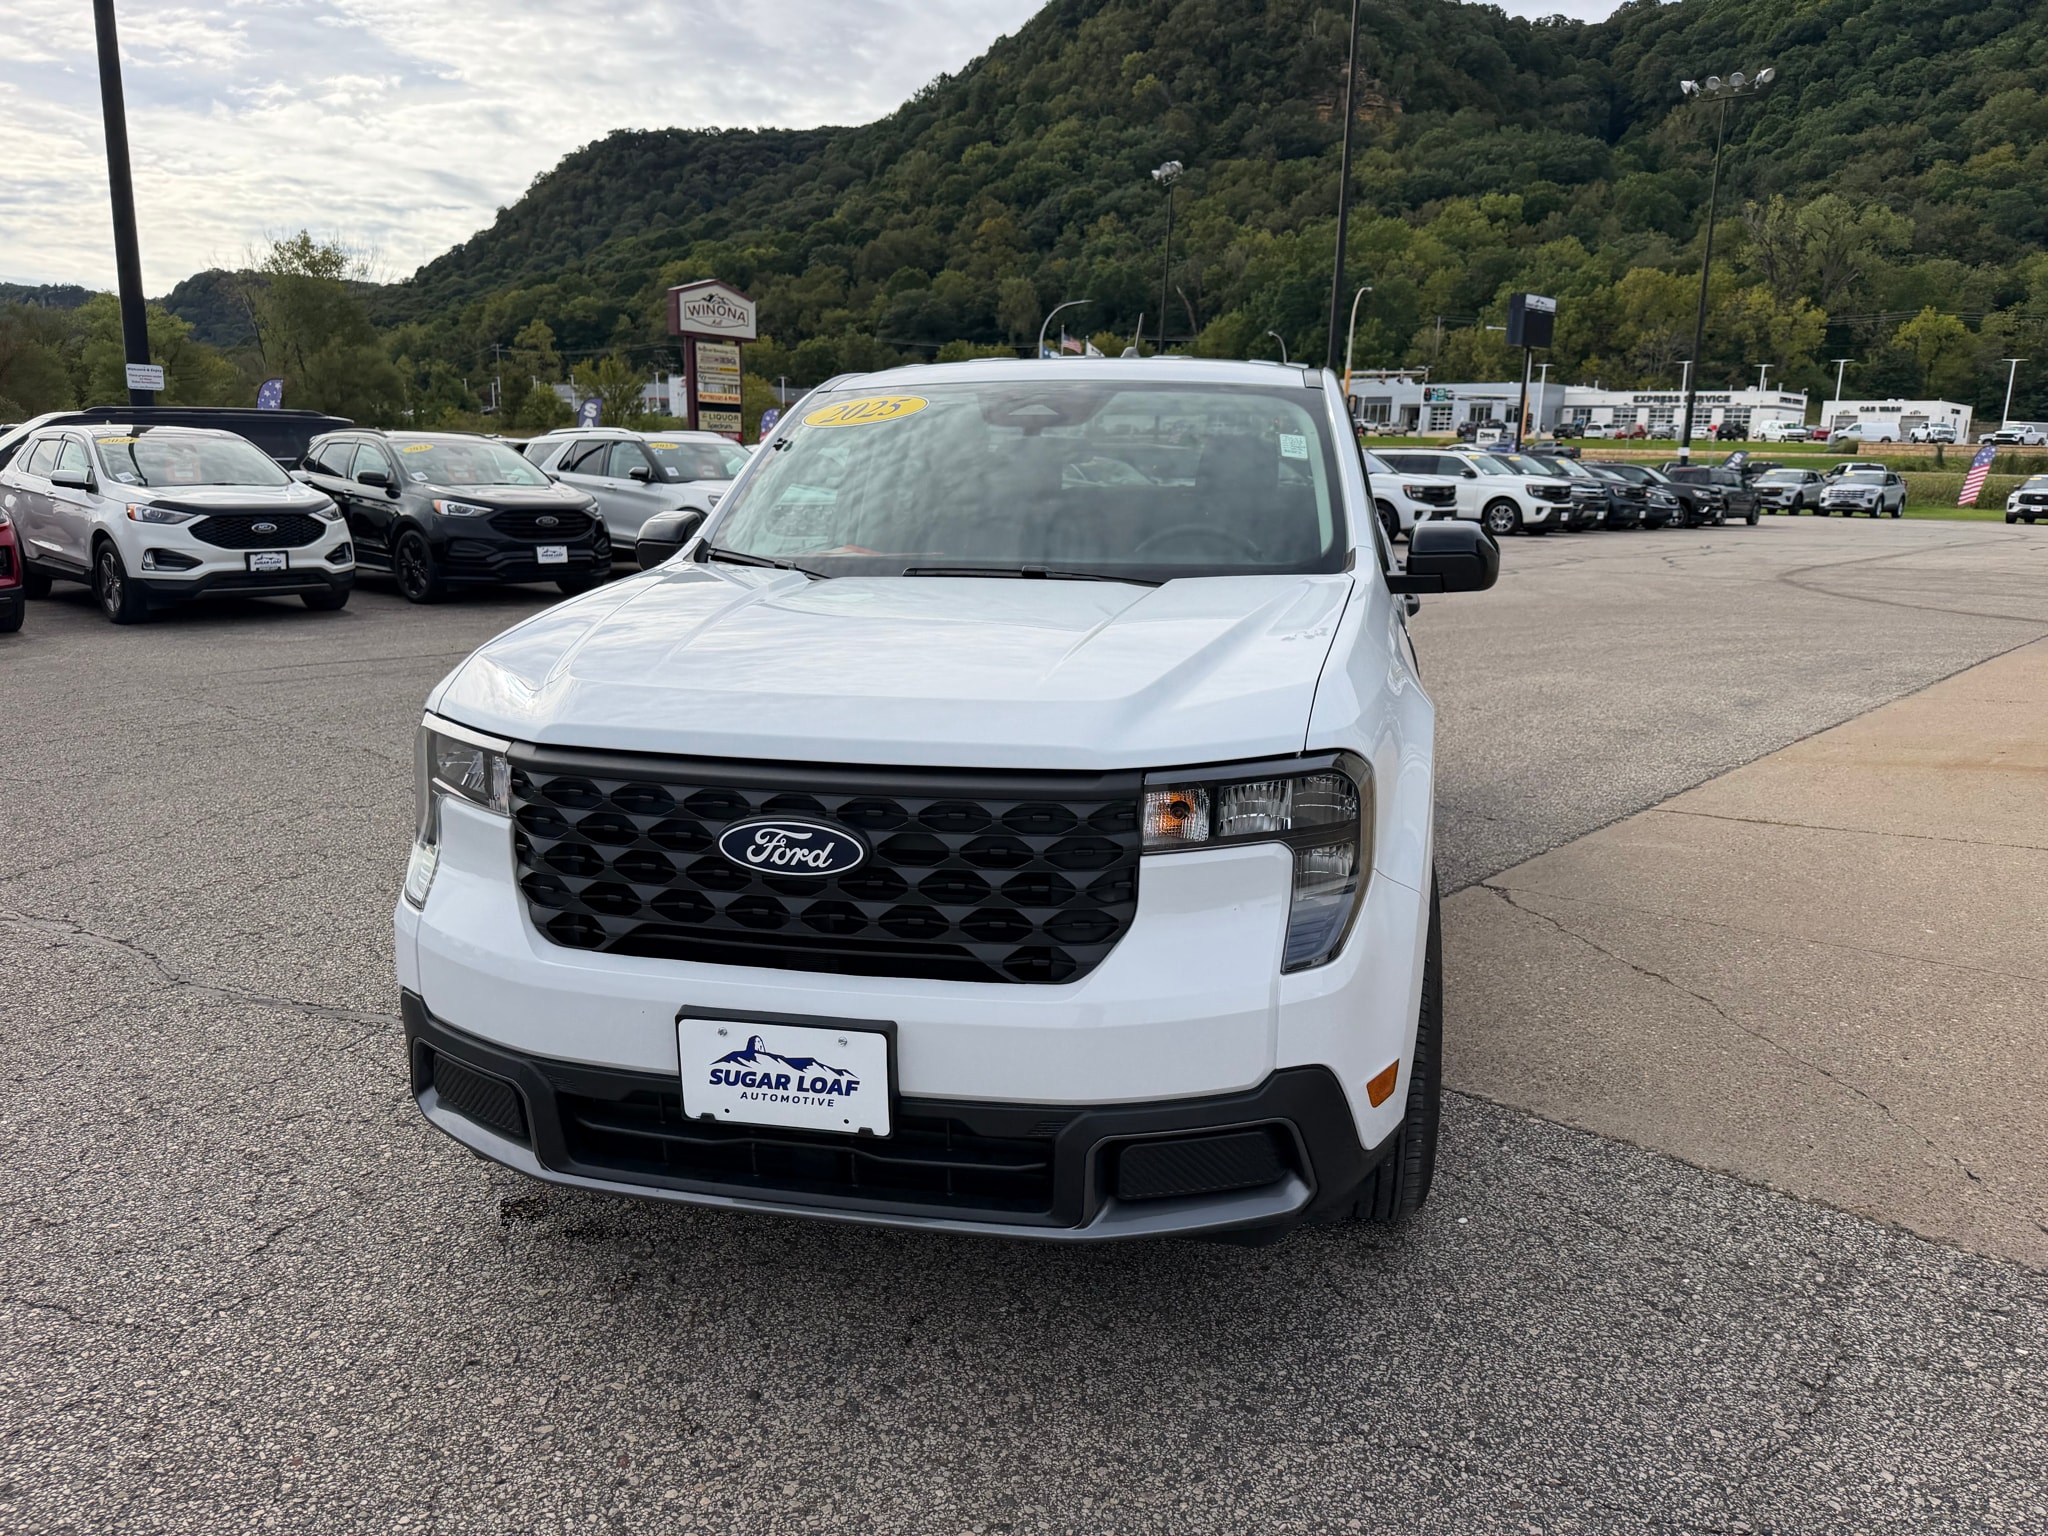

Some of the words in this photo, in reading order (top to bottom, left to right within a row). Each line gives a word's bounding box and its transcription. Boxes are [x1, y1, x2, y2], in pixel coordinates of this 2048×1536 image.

[687, 303, 746, 323] WINONA
[1633, 395, 1681, 403] EXPRESS
[1684, 395, 1731, 403] SRVICE
[708, 413, 739, 421] LIQUOR
[818, 398, 911, 424] 2025
[746, 828, 835, 868] Ford
[709, 1068, 791, 1091] SUGAR
[796, 1075, 860, 1097] LOAF
[740, 1091, 835, 1107] AUTOMOTIVE
